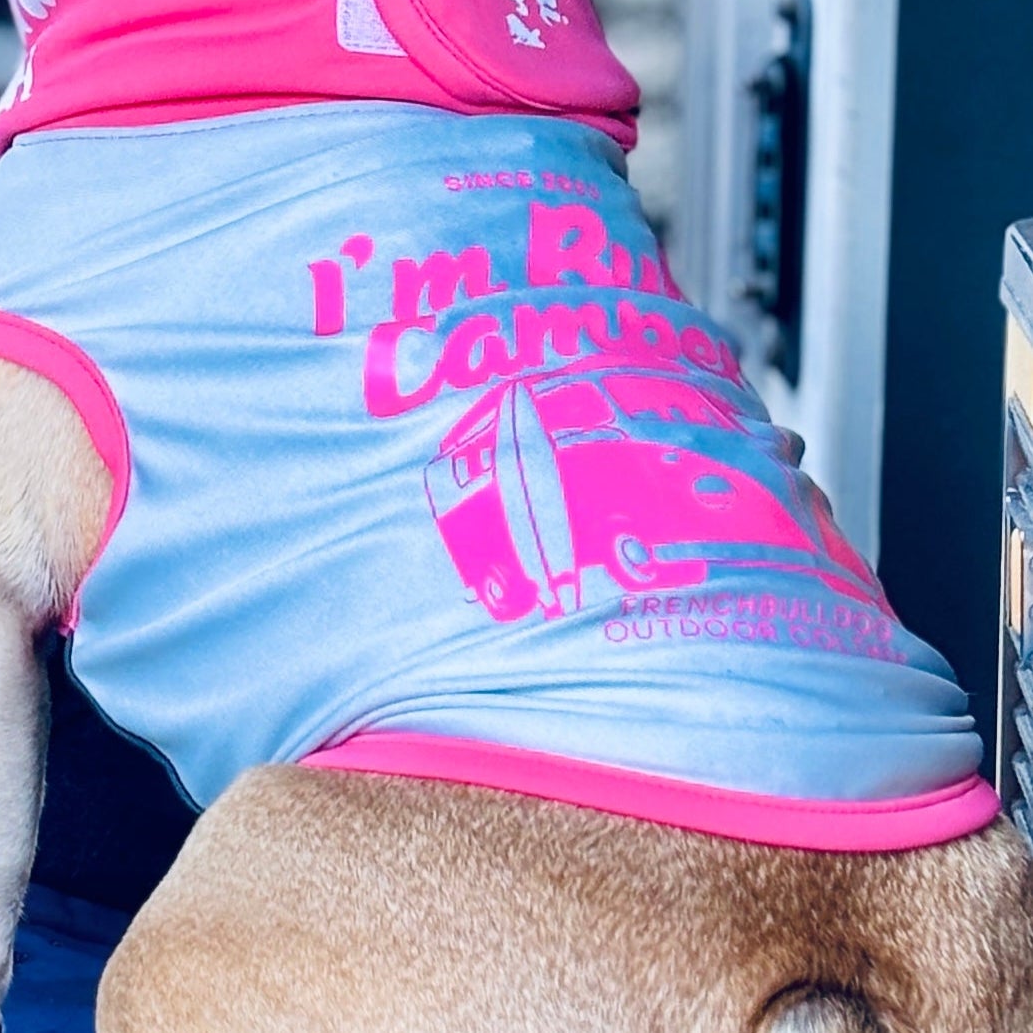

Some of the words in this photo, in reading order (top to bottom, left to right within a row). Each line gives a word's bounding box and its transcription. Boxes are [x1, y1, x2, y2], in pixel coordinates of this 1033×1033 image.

[444, 171, 533, 193] SINCE
[308, 233, 508, 337] I'm
[604, 617, 778, 643] OUTDOOR
